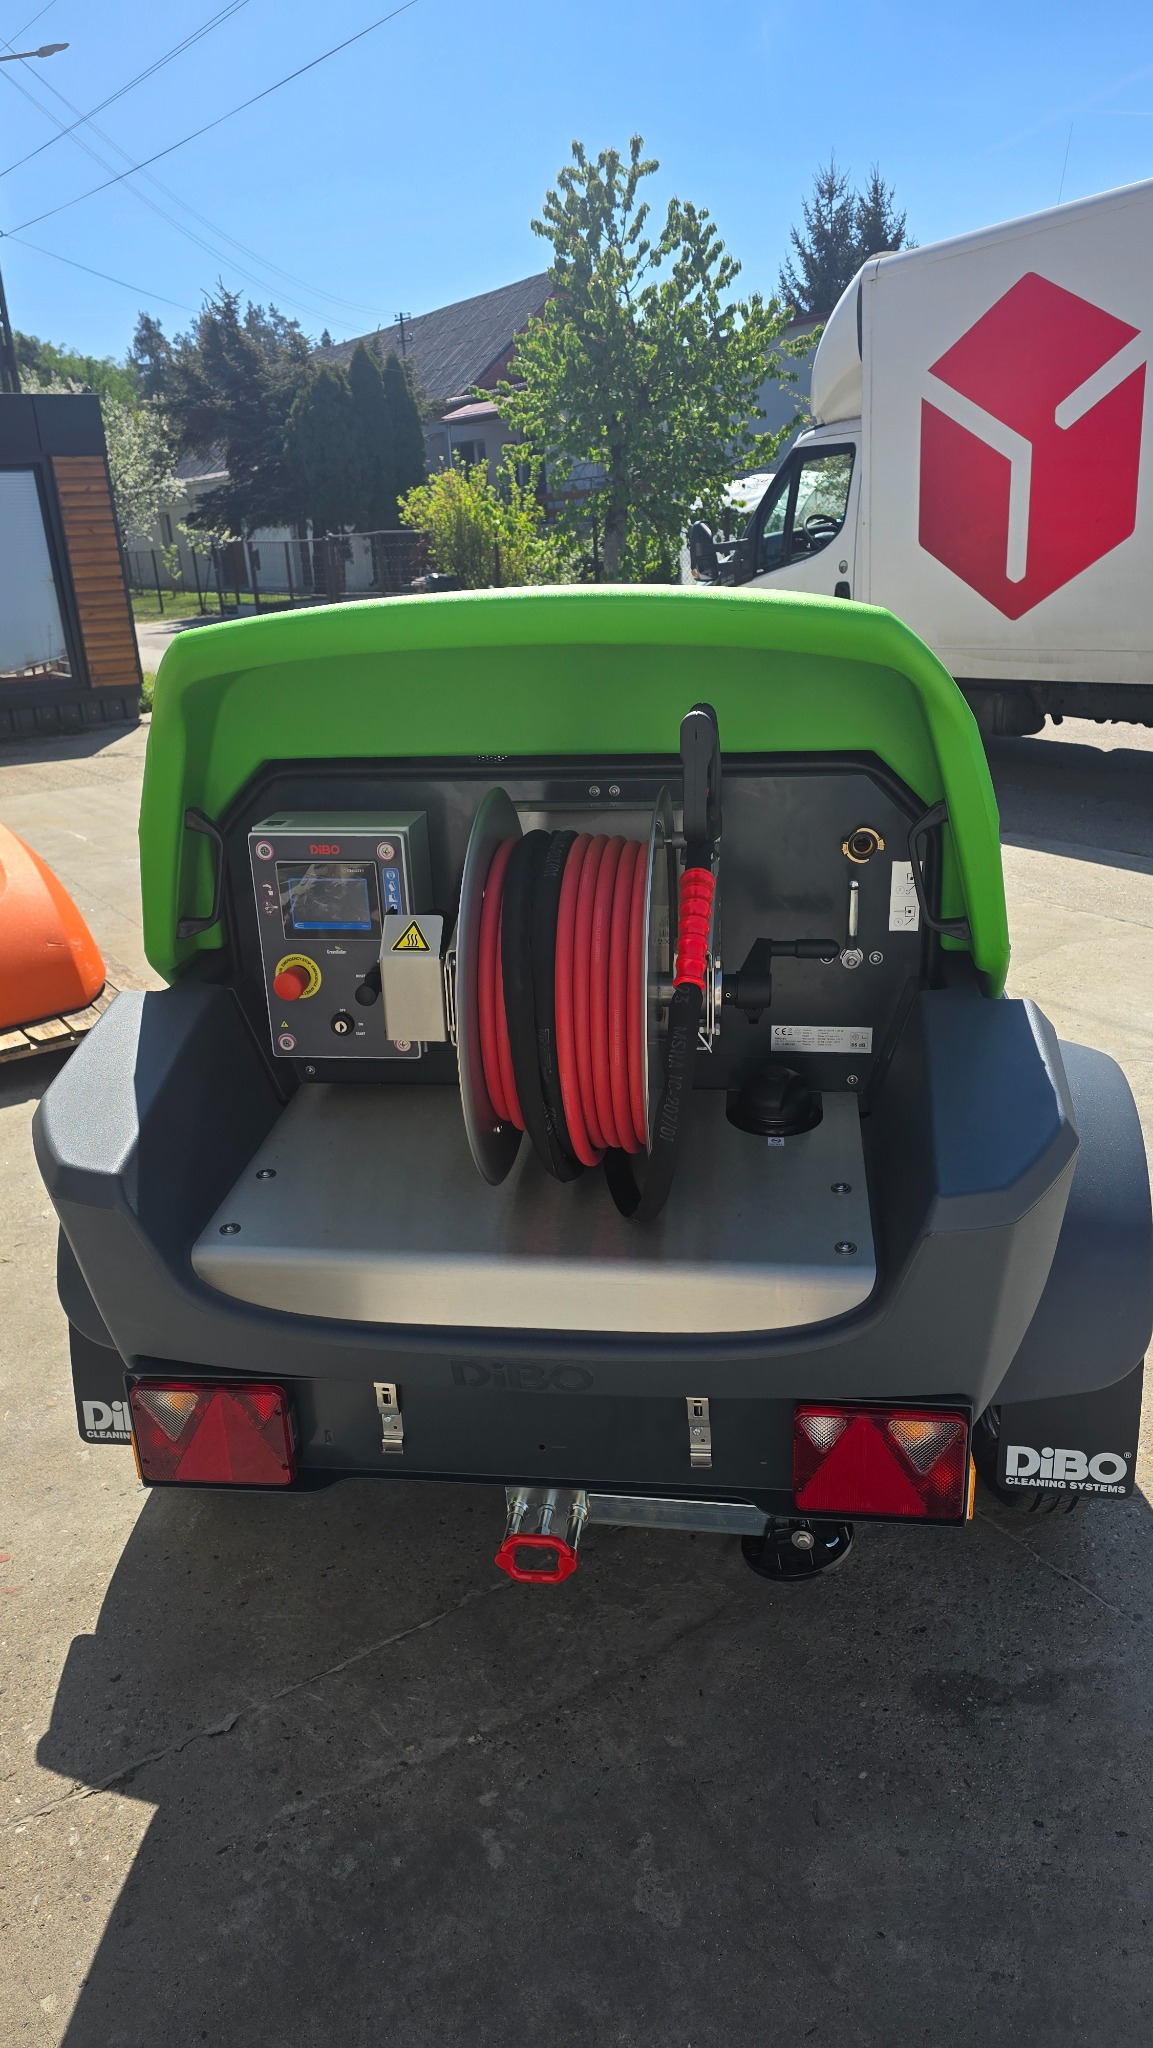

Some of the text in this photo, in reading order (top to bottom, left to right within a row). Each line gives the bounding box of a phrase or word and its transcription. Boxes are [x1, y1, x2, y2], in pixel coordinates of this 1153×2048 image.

[668, 1025, 688, 1069] MSHA
[86, 1431, 131, 1440] CLEANIN
[1005, 1477, 1126, 1494] CLEANING SYSTEMS
